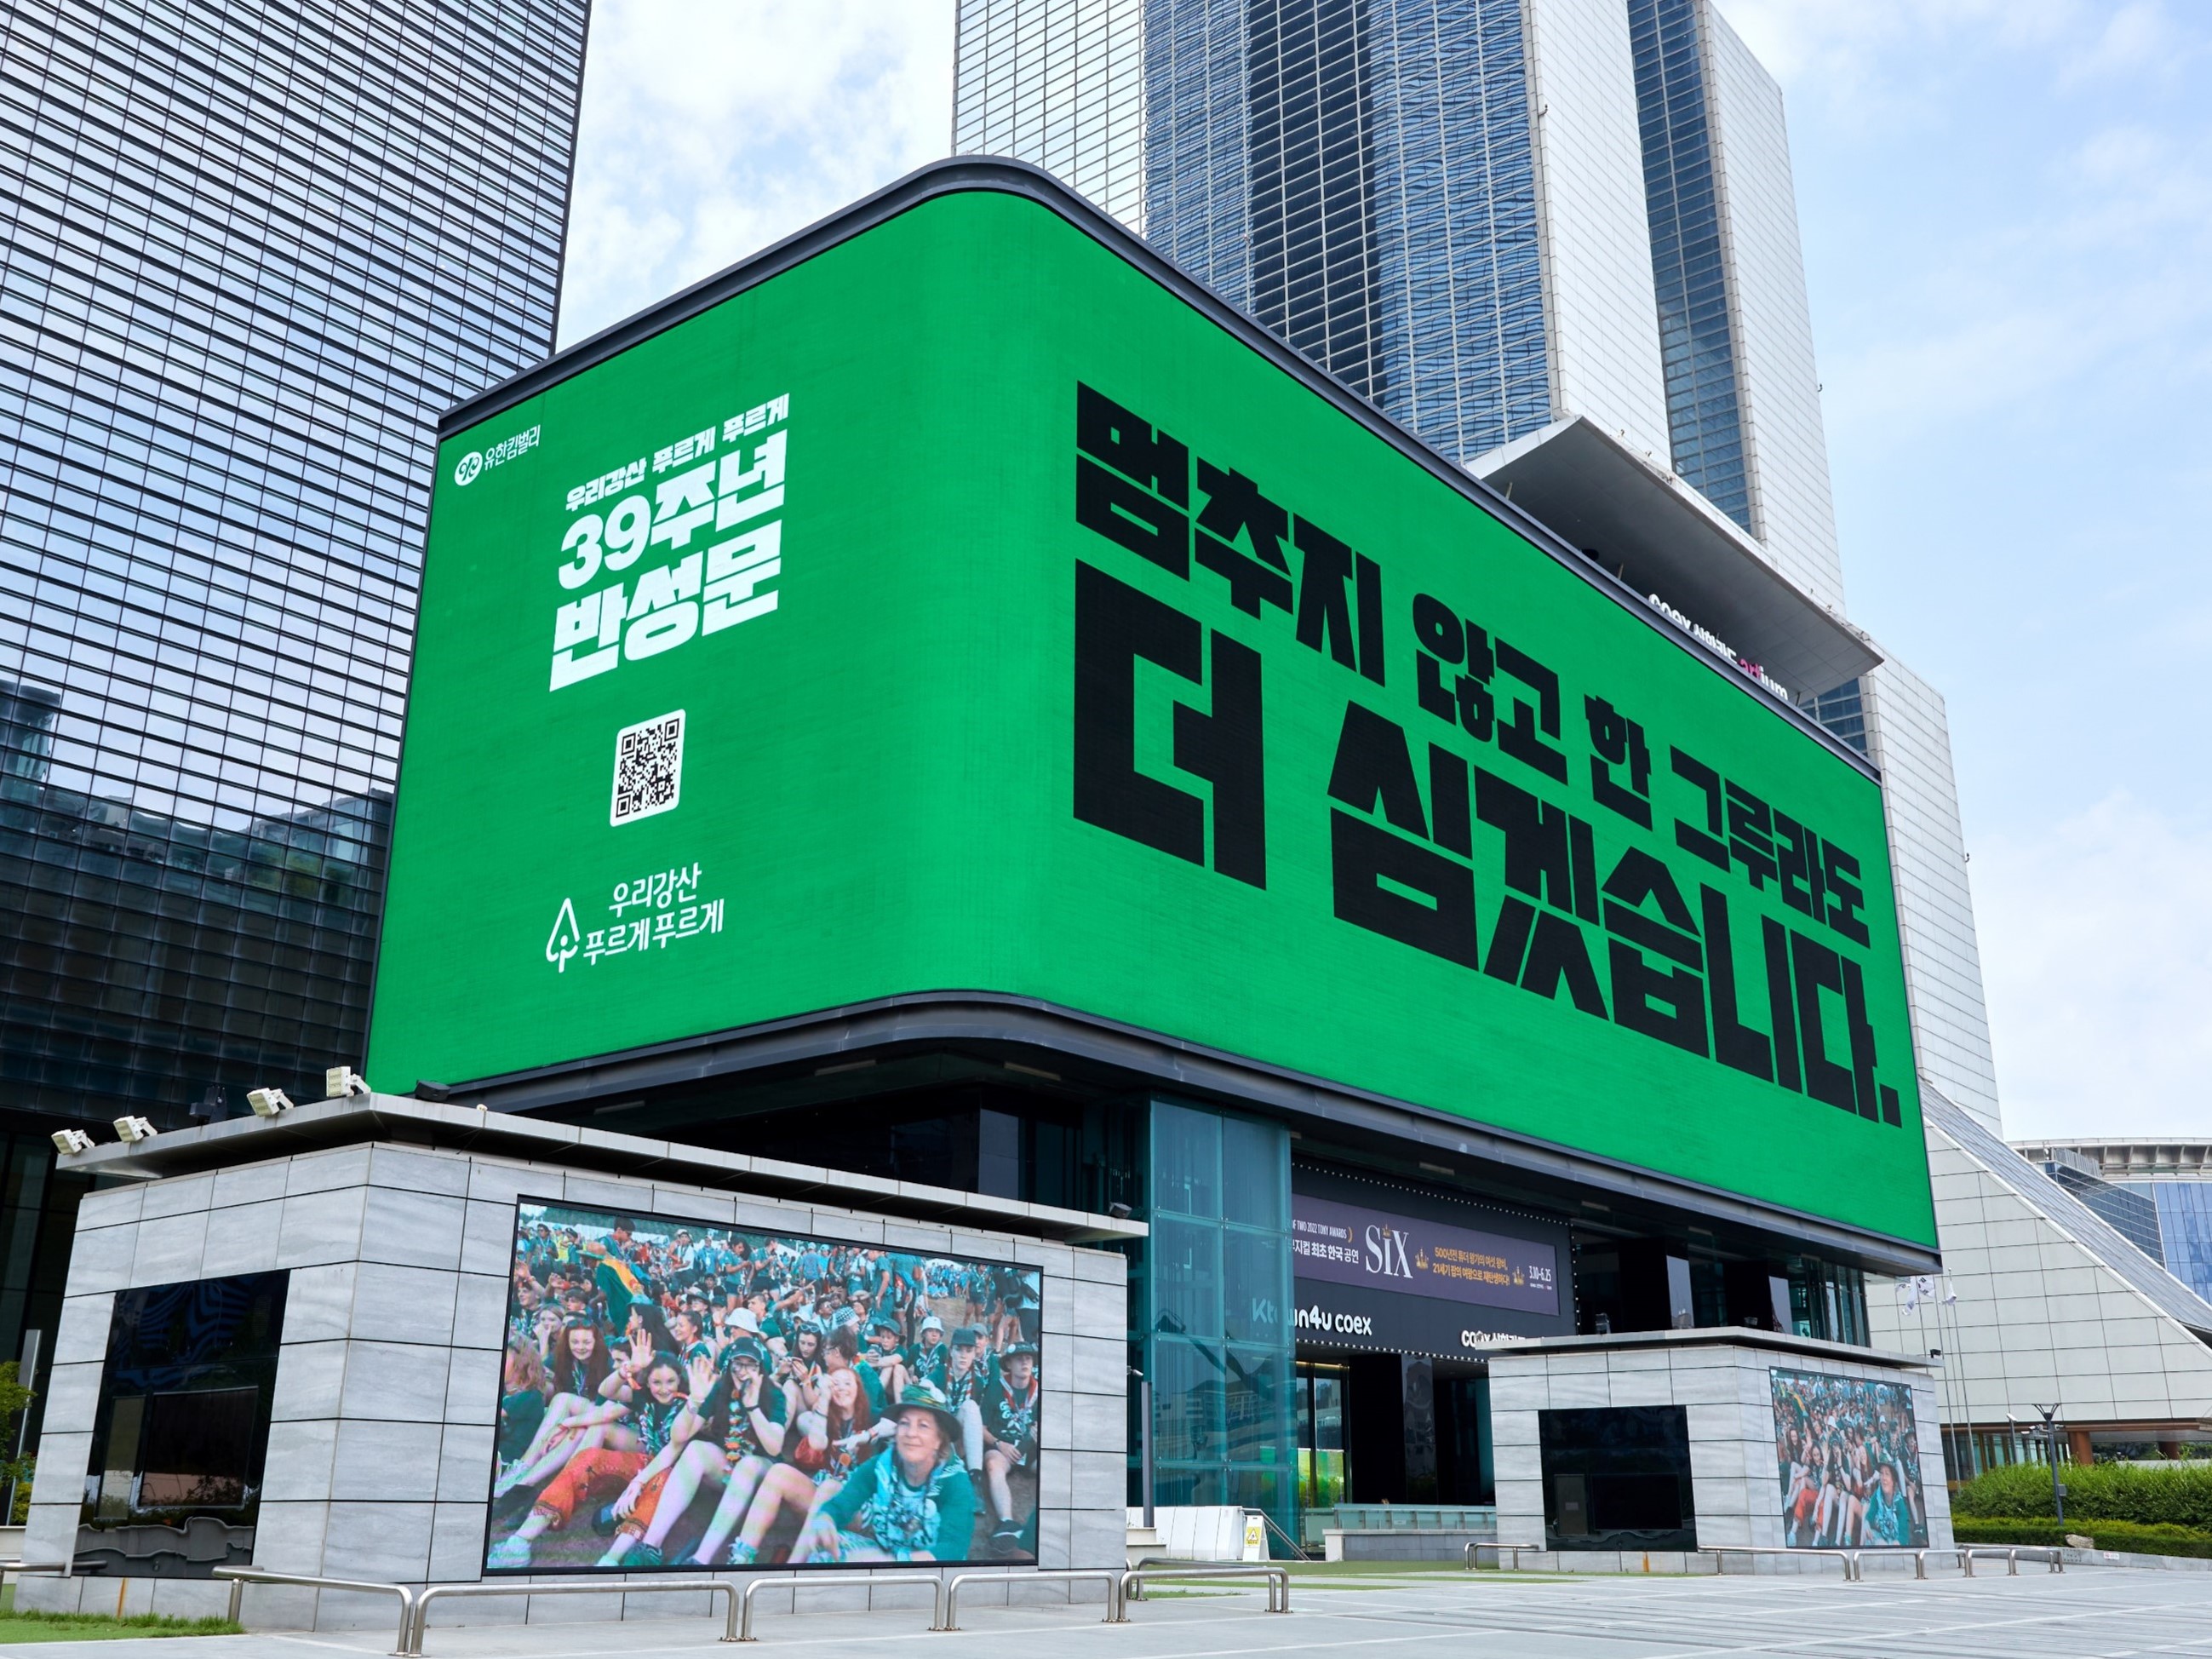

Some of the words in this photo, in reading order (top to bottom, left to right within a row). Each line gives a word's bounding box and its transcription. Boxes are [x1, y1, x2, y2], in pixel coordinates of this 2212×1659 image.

[484, 425, 541, 471] 유한킴벌리
[565, 457, 647, 512] 우리강산
[652, 426, 716, 474] 푸르게
[722, 393, 789, 443] 푸르게
[559, 428, 788, 590] 39주년
[549, 520, 782, 692] 반성문
[1075, 380, 1385, 688] 멈추지
[1413, 593, 1568, 786] 않고
[1584, 694, 1653, 832] 한
[1670, 744, 1871, 950] 그루라도
[1073, 558, 1266, 891] 더
[1327, 701, 1902, 1128] 심겠습니다.
[609, 862, 702, 918] 우리강산
[1307, 1222, 1317, 1233] 2022
[1329, 1226, 1347, 1239] AWARDS
[1311, 1242, 1327, 1257] 최초
[1327, 1244, 1343, 1261] 한국
[1344, 1248, 1359, 1264] 공연
[1252, 1298, 1332, 1331] Ktwn4u
[1335, 1313, 1372, 1336] coex
